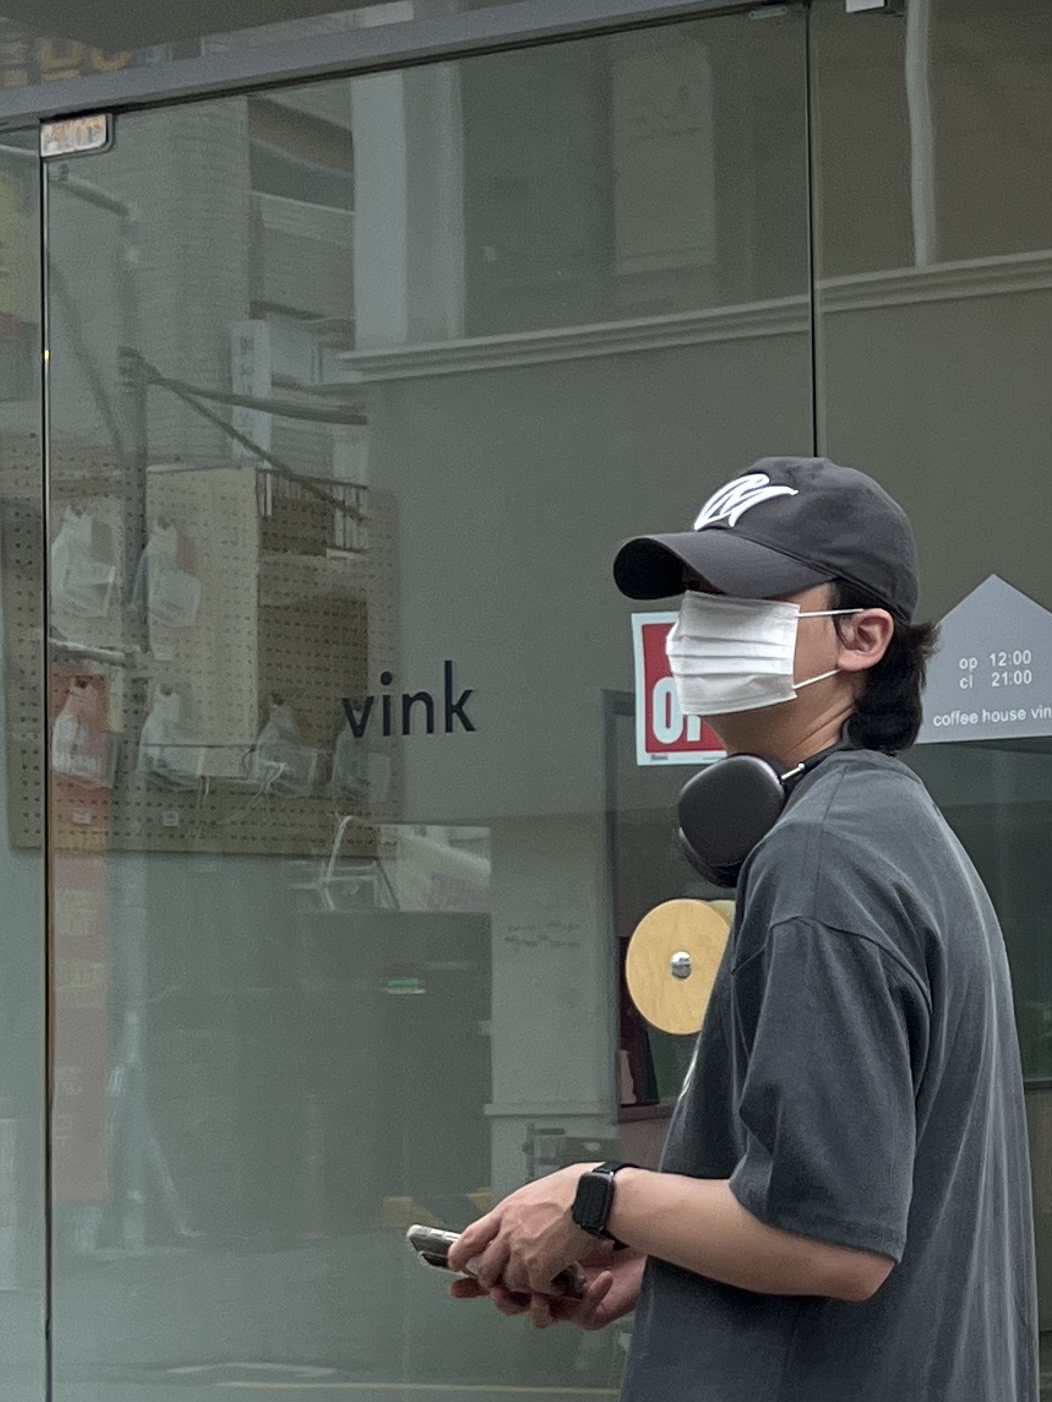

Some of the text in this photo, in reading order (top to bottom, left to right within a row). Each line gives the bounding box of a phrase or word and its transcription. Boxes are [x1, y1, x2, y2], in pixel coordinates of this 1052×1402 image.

[958, 649, 1032, 672] op 12:00
[991, 669, 1033, 687] 21:00
[341, 659, 476, 738] vink
[933, 710, 979, 727] coffee
[982, 708, 1027, 723] house
